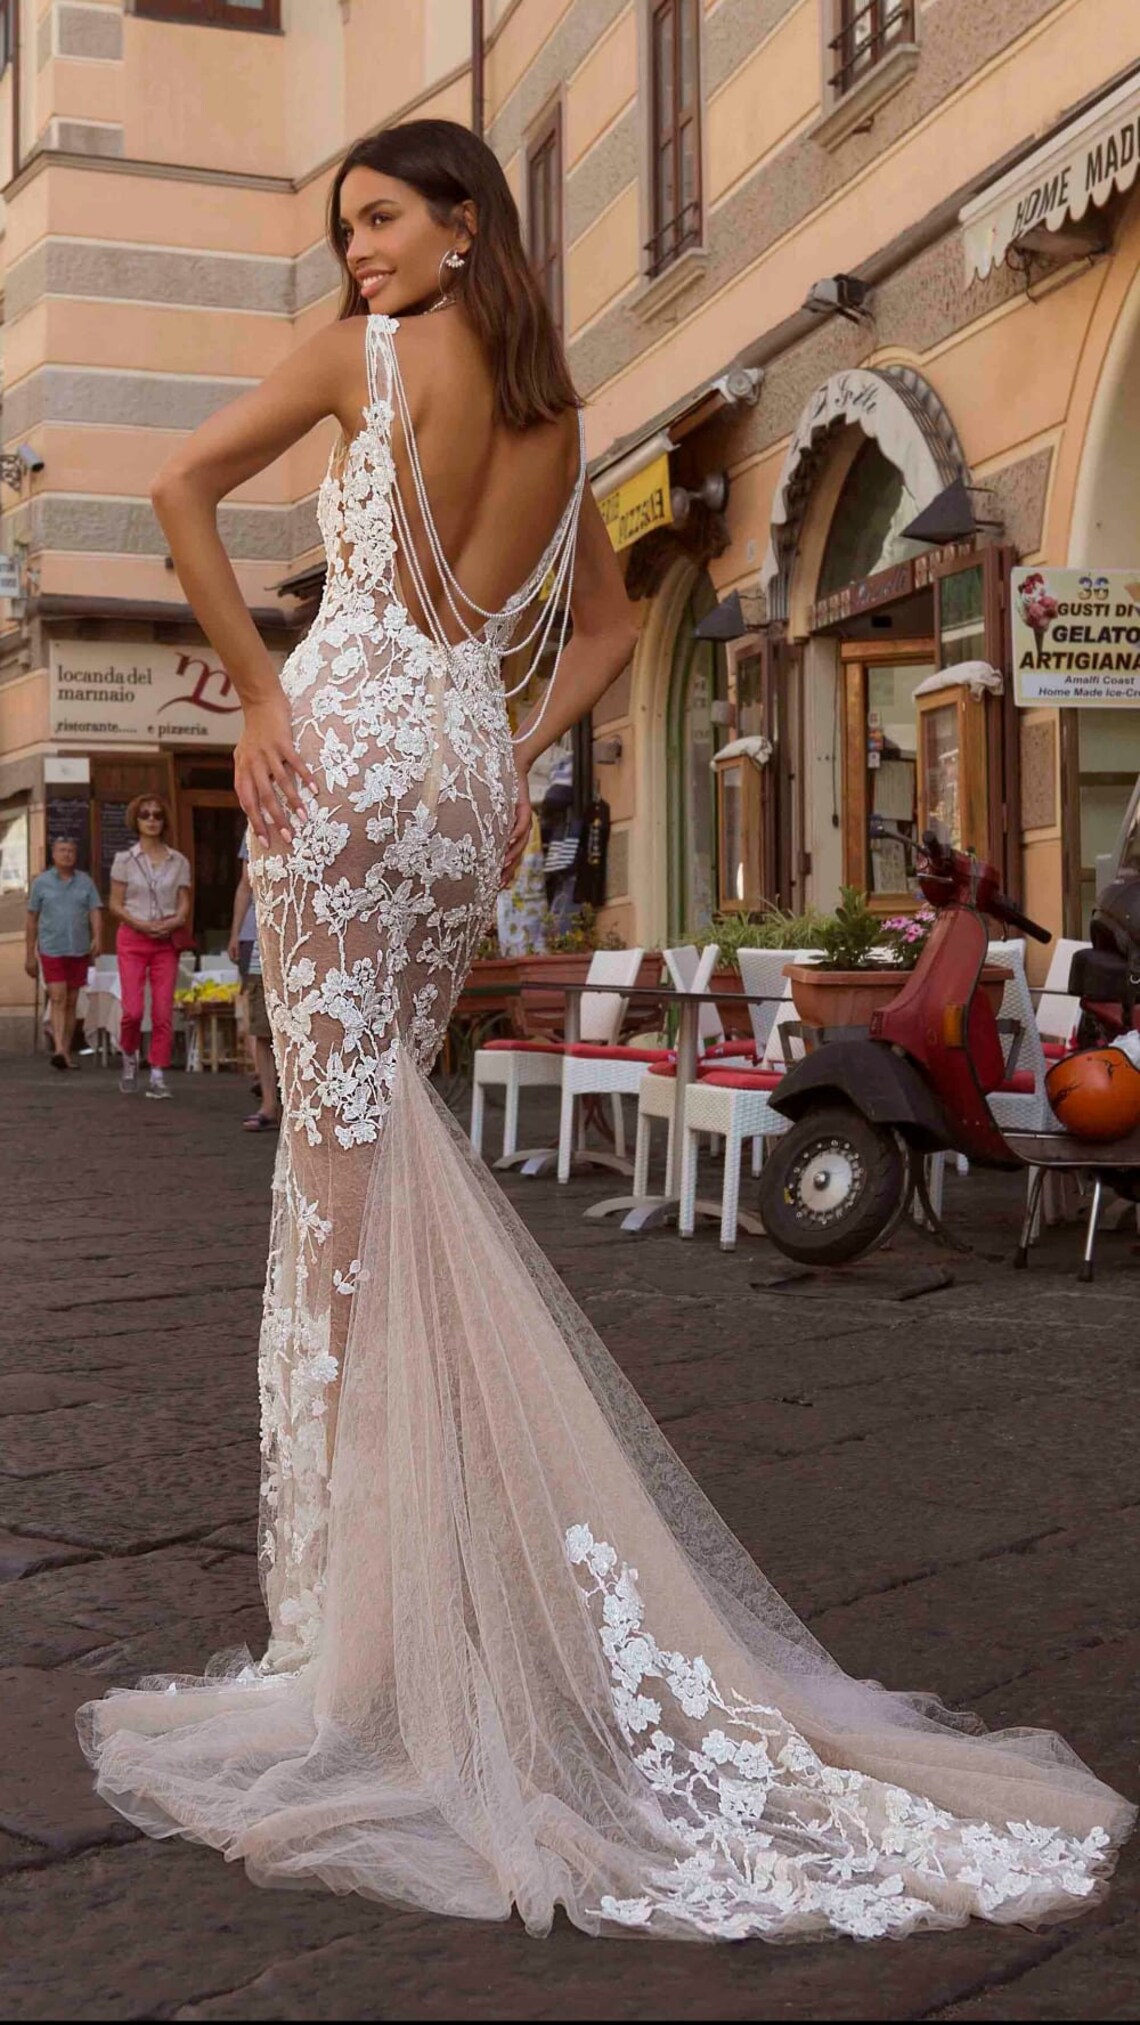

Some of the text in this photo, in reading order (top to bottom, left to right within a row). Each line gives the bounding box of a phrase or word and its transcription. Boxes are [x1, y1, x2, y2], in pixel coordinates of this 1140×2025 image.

[1011, 116, 1140, 238] HOME MAD
[1057, 602, 1134, 618] GUSTI DI
[1052, 625, 1140, 645] GELATO
[58, 664, 153, 686] locanda del
[1064, 675, 1135, 686] Amalfi Coast
[58, 687, 136, 703] marinaio
[1039, 687, 1071, 698] Home
[1073, 687, 1103, 698] Made
[158, 723, 208, 739] pizzeria
